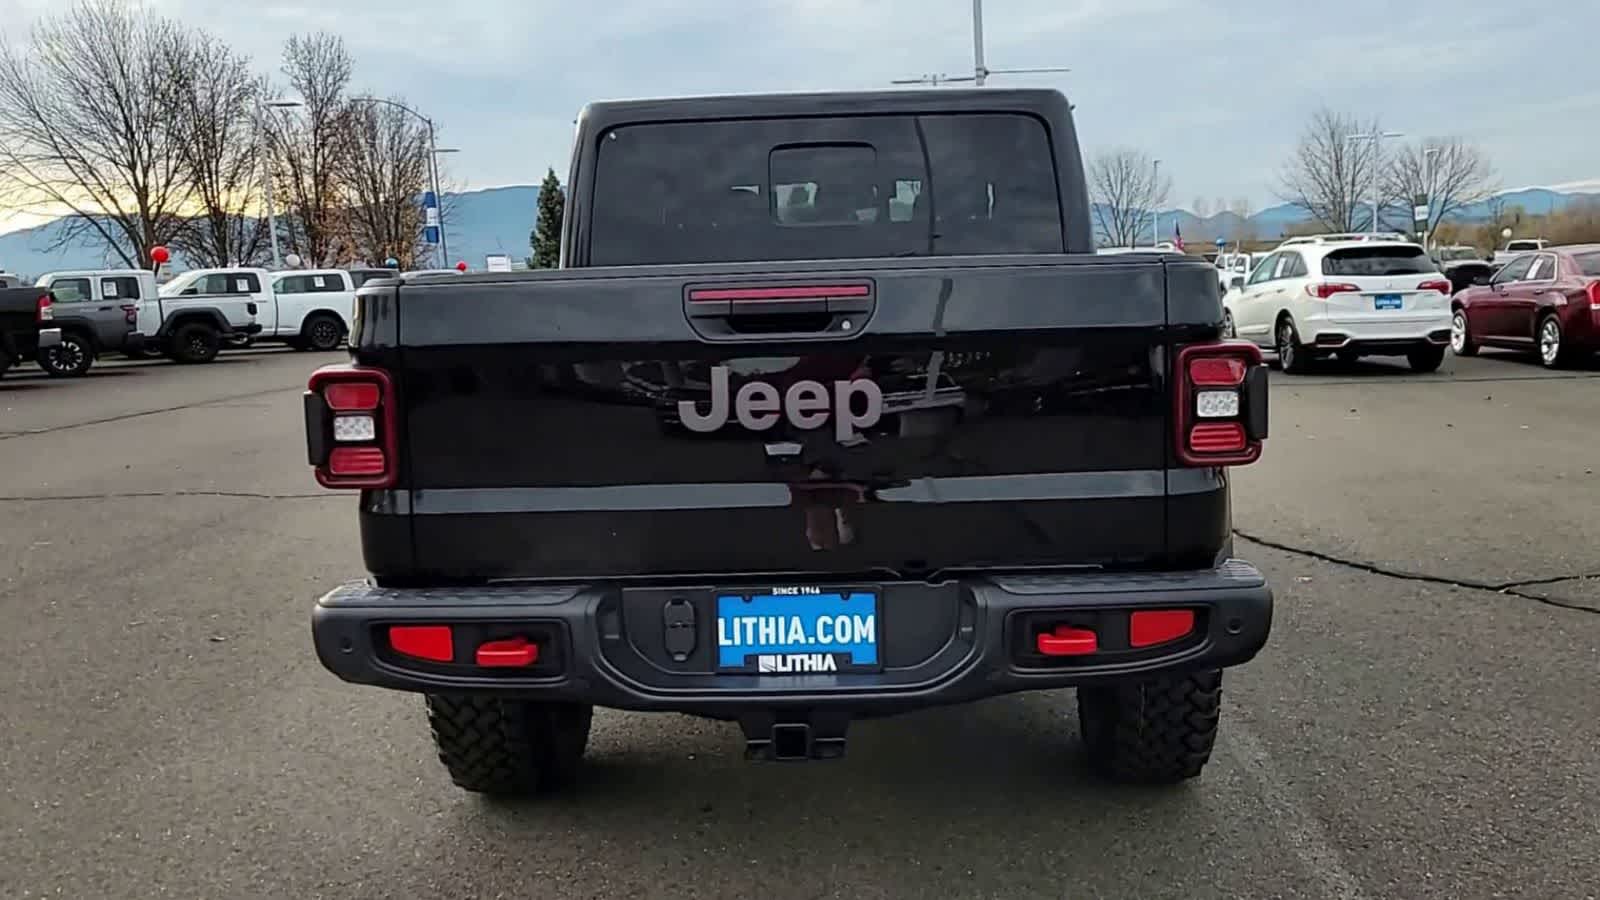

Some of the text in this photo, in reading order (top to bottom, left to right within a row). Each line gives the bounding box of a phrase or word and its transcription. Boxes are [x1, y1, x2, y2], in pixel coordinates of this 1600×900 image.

[678, 366, 883, 442] Jeep
[772, 587, 799, 595] SINCE
[717, 615, 875, 646] LITHIA.COM
[776, 654, 837, 672] LITHIA
